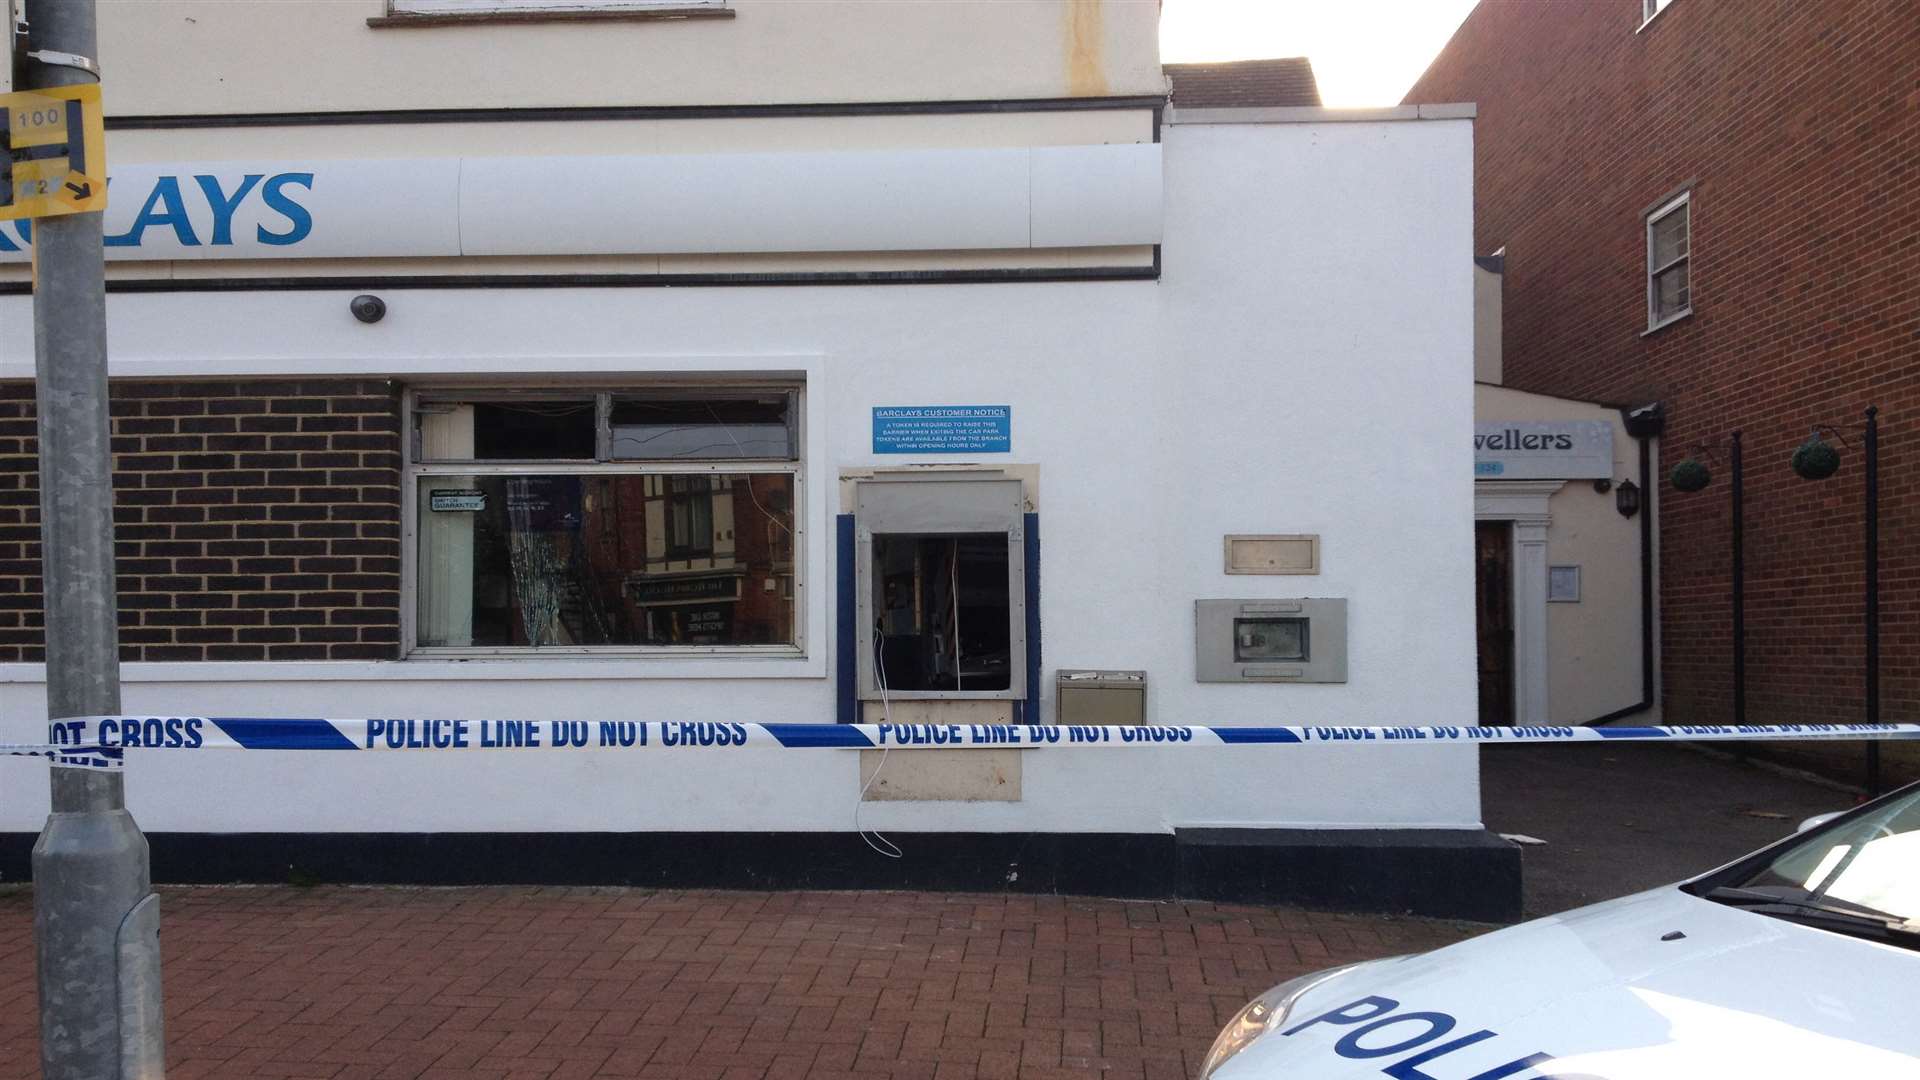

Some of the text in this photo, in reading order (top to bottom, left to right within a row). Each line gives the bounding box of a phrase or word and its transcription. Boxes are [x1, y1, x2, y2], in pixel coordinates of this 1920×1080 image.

[19, 109, 58, 127] 100
[49, 718, 203, 748] OT CROSS
[366, 719, 748, 748] POLICE LINE DO NOT CROSS
[879, 724, 962, 745] POLICE
[970, 725, 1021, 744] LINE
